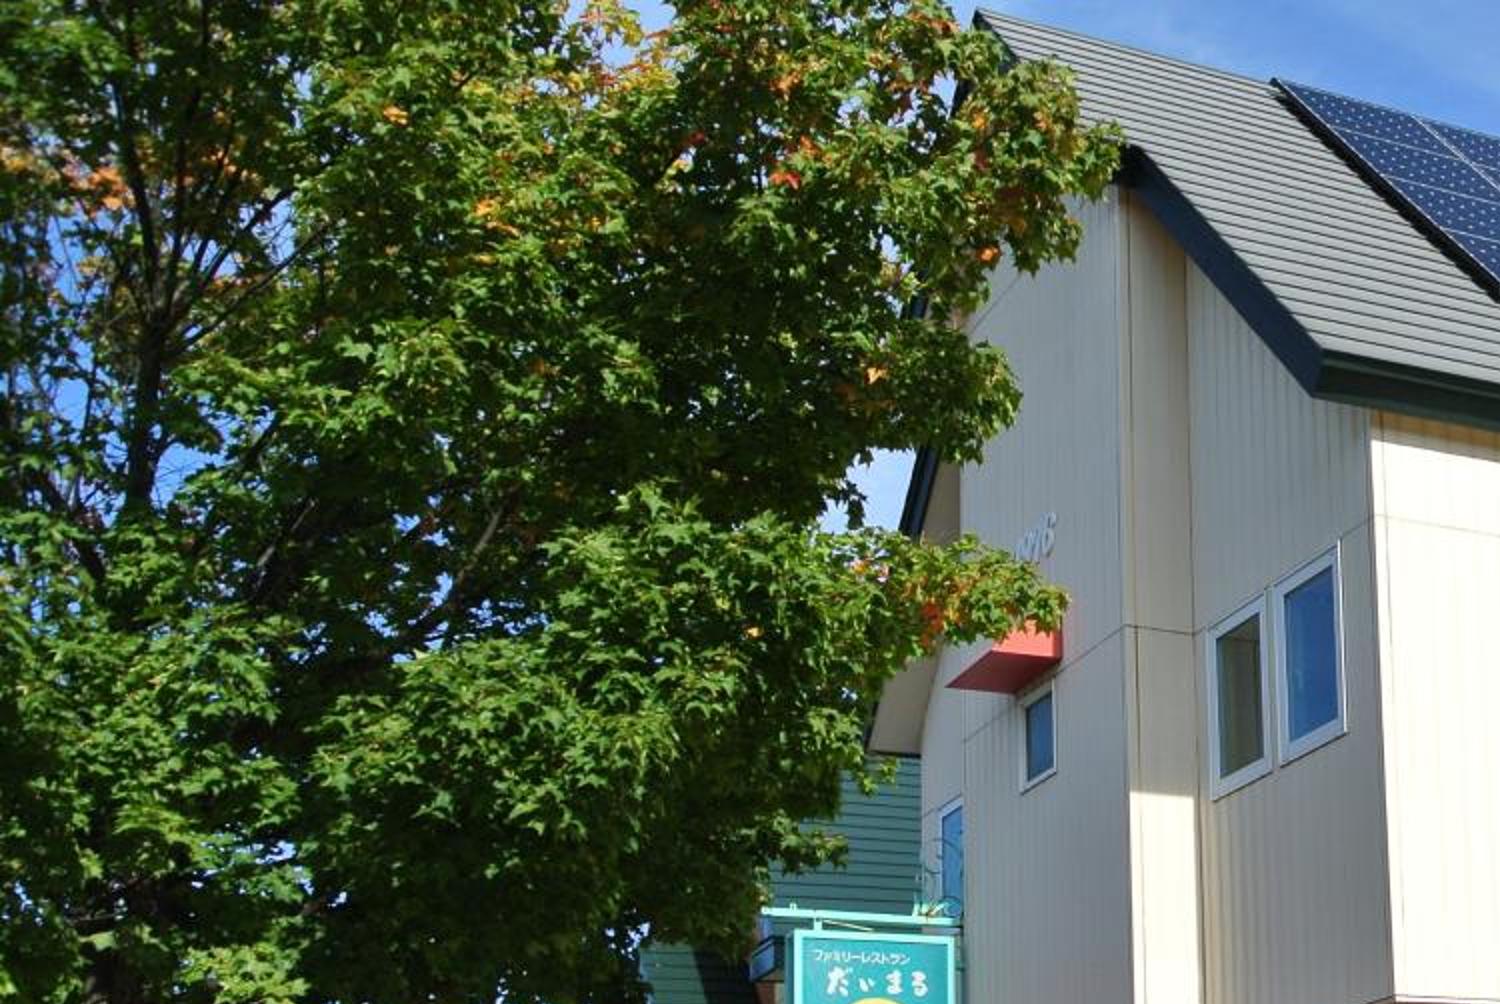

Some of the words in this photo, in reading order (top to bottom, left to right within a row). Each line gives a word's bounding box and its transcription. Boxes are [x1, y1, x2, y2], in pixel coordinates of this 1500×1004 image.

[814, 949, 910, 965] ファミリーレストラン
[826, 965, 929, 998] だいまる
